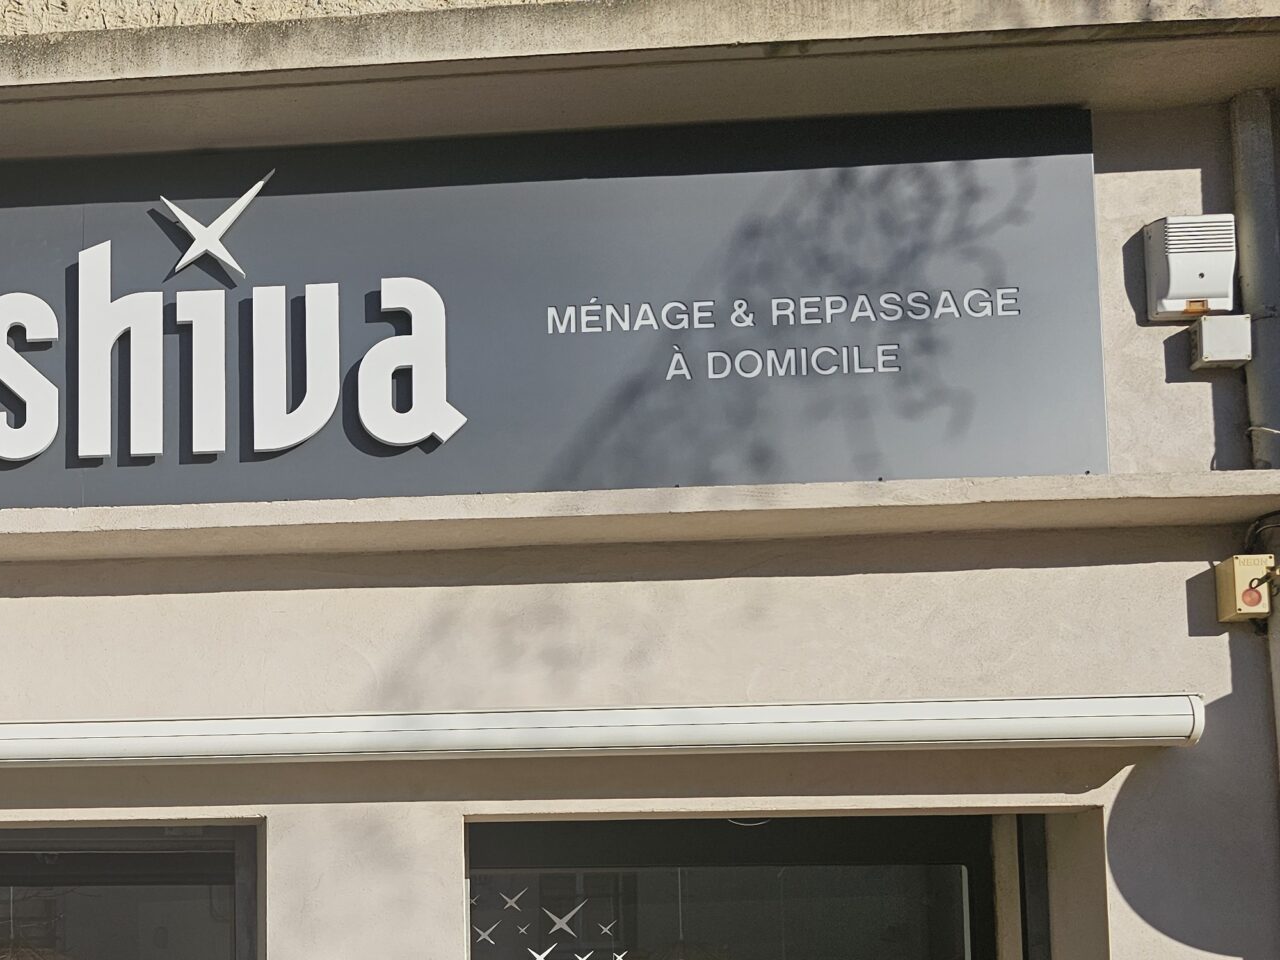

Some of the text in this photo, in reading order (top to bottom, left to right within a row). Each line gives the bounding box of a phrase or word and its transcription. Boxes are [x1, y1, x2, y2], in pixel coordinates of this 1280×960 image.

[547, 287, 1020, 334] MÉNAGE & REPASSAGE
[666, 344, 901, 380] À DOMICILE
